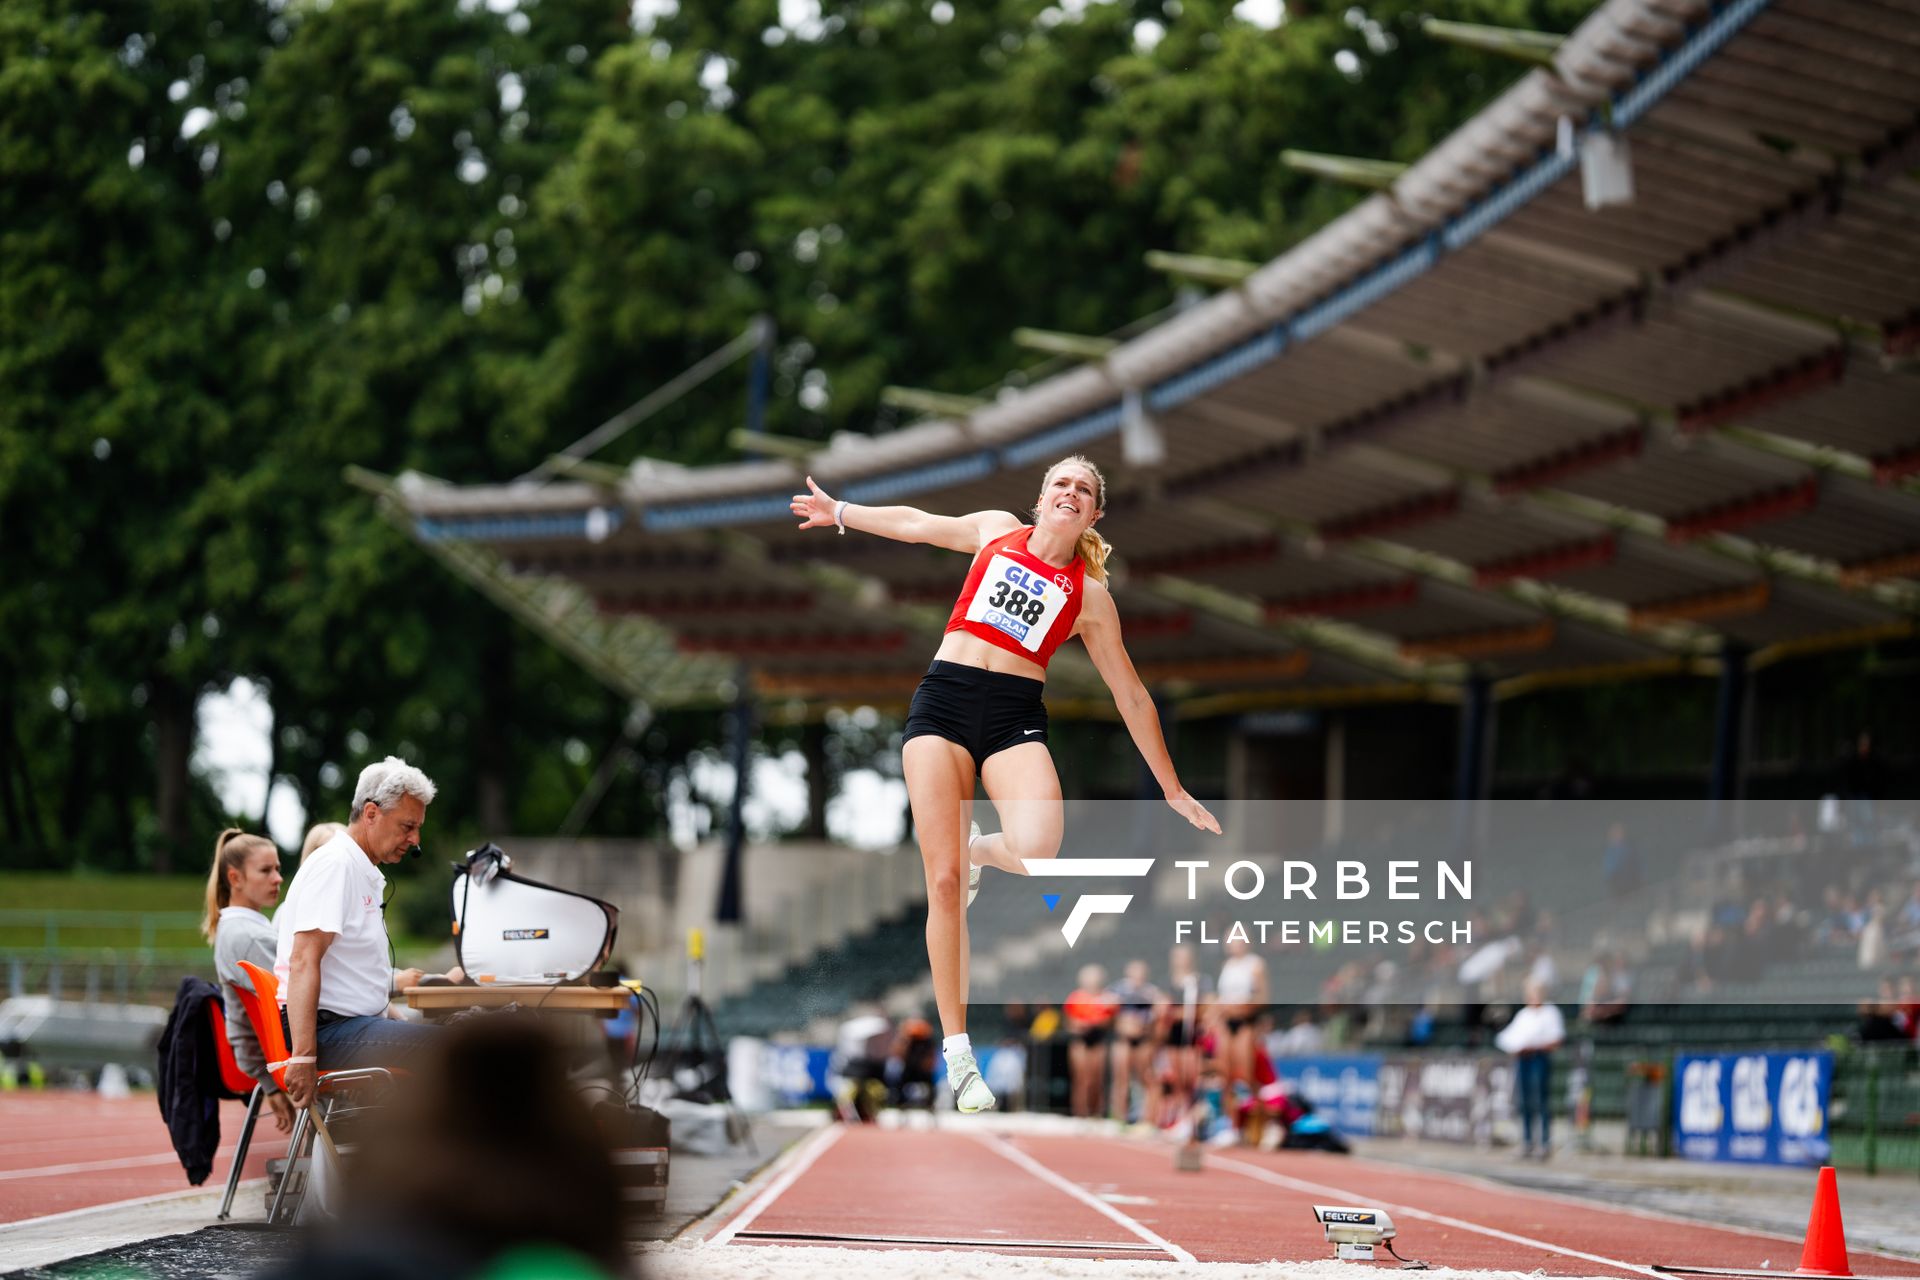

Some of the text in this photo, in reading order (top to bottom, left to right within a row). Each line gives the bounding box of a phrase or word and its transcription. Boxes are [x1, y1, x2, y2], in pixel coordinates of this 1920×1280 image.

[1004, 566, 1047, 596] GLS
[988, 581, 1045, 626] 388
[1001, 617, 1027, 636] PLAN
[1325, 1212, 1359, 1222] SELTEC
